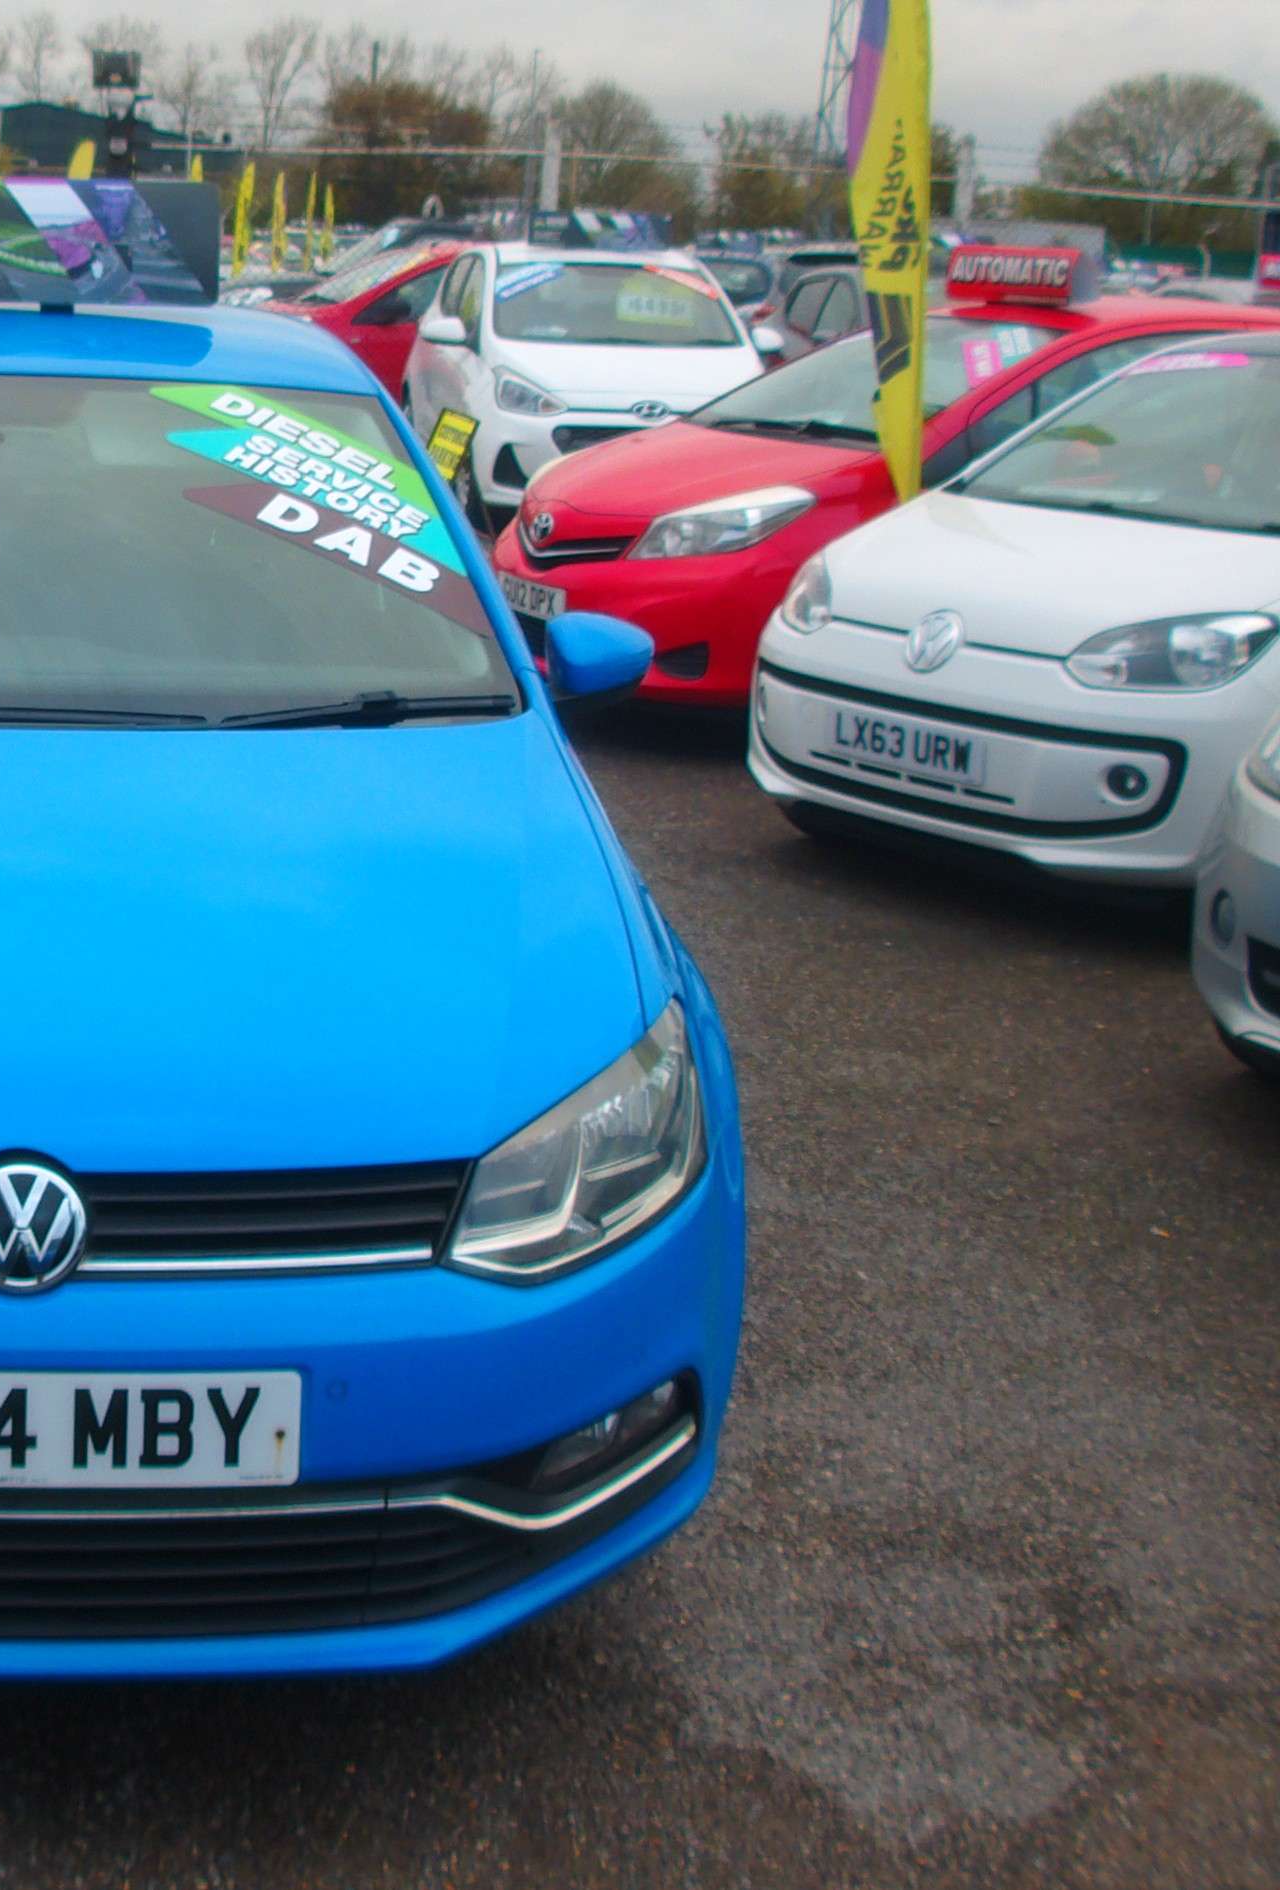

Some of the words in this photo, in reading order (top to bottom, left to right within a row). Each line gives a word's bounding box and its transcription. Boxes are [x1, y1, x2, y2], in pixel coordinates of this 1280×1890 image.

[952, 255, 1070, 288] AUTOMATIC
[209, 391, 396, 490] DIESEL
[244, 433, 430, 531] SERVICE
[222, 445, 420, 540] HISTORY
[256, 493, 440, 592] DAB
[834, 711, 906, 759] LX63
[912, 729, 973, 774] URW
[72, 1386, 262, 1469] MBY
